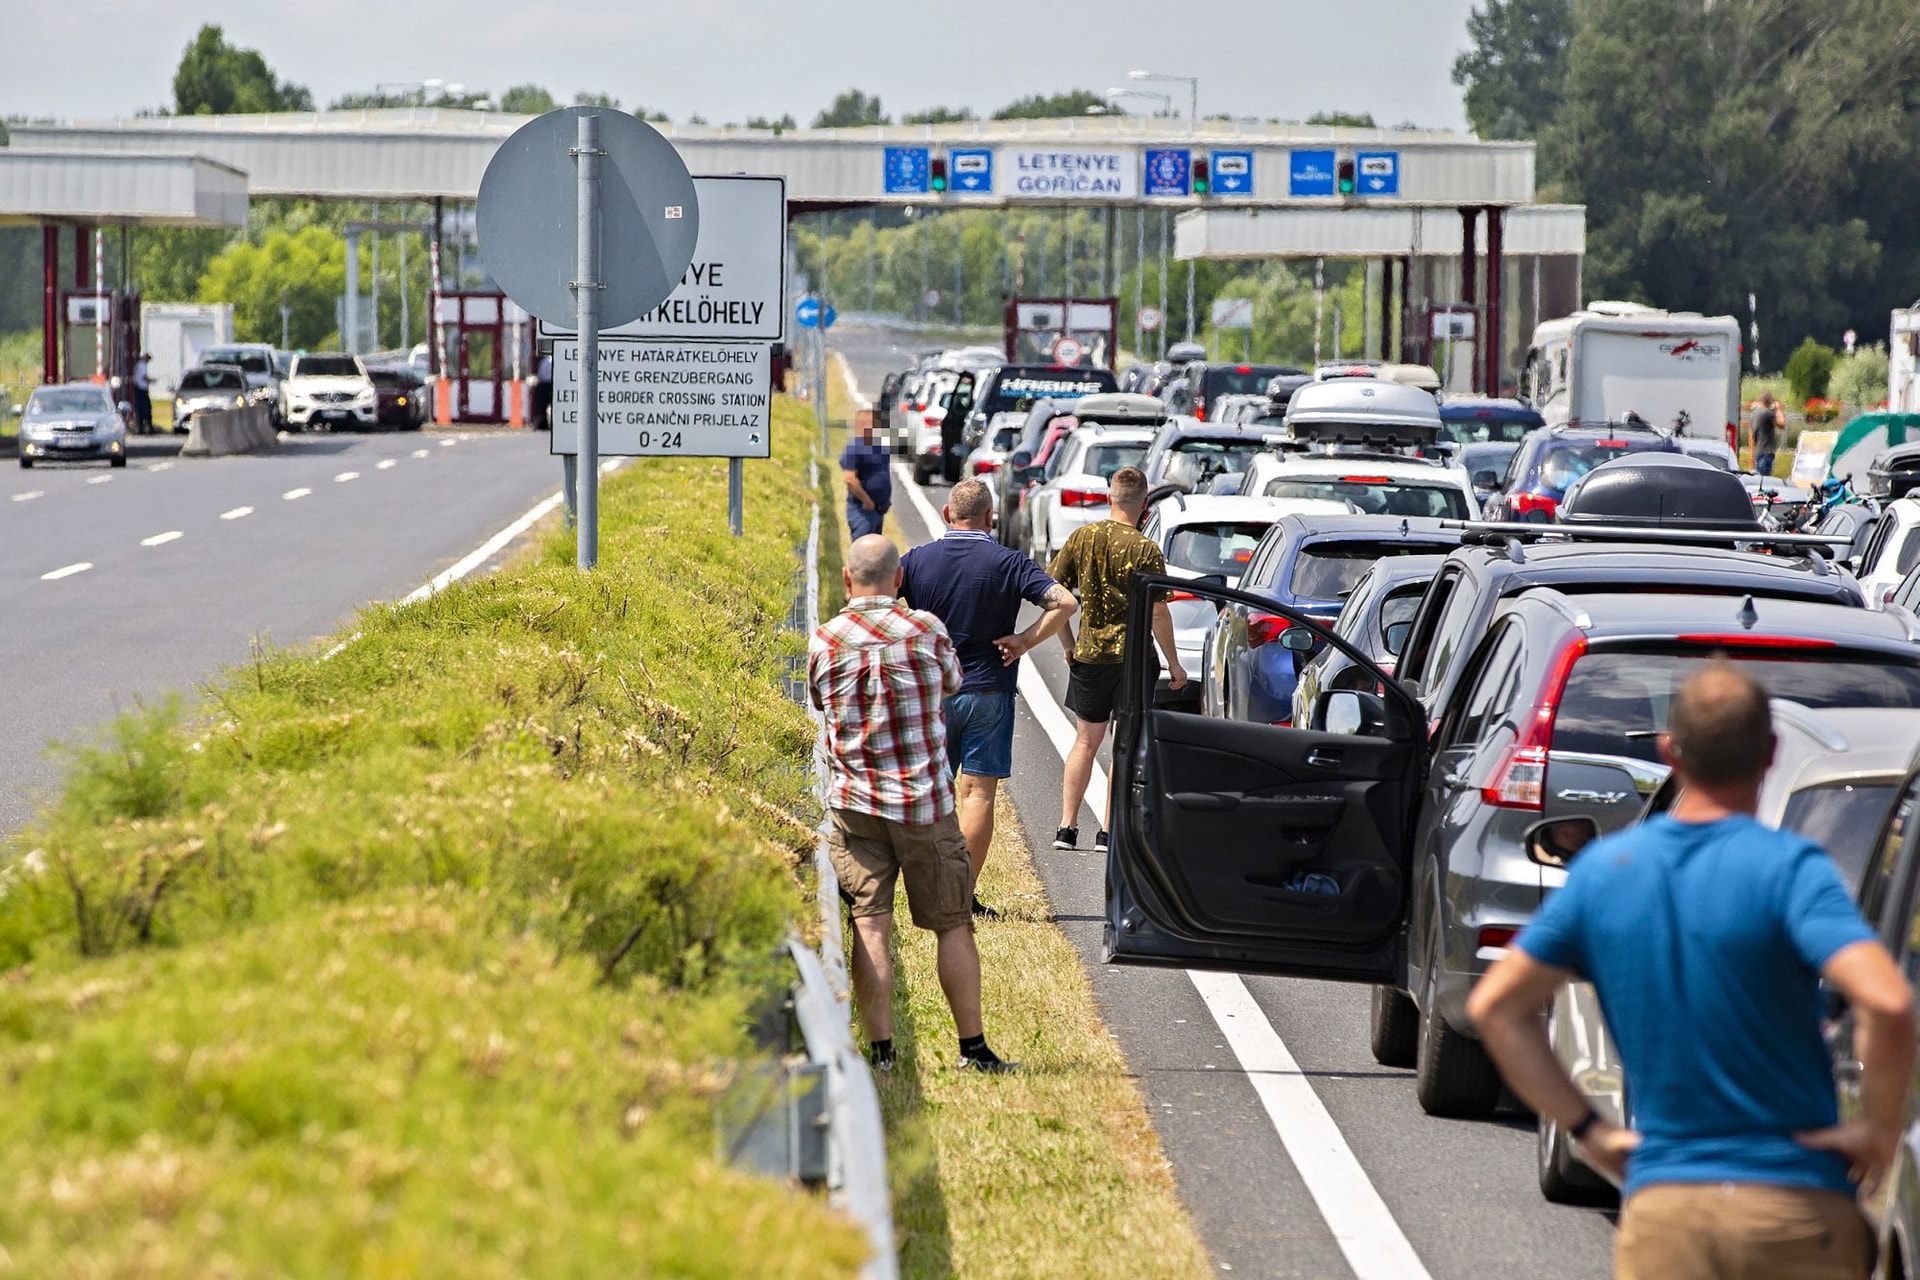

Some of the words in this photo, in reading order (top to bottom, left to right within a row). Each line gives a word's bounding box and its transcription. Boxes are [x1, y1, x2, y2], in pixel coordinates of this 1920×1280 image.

[1017, 153, 1121, 170] LETENYE
[564, 348, 625, 362] LENYE
[569, 370, 630, 383] LENYE
[634, 369, 753, 384] GRENZÜBERGANG
[608, 391, 654, 404] BORDER
[659, 392, 715, 405] CROSSING
[721, 393, 766, 407] STATION
[562, 411, 622, 424] LENYE
[626, 410, 690, 425] GRANIČNI
[693, 413, 759, 427] PRIJELAZ
